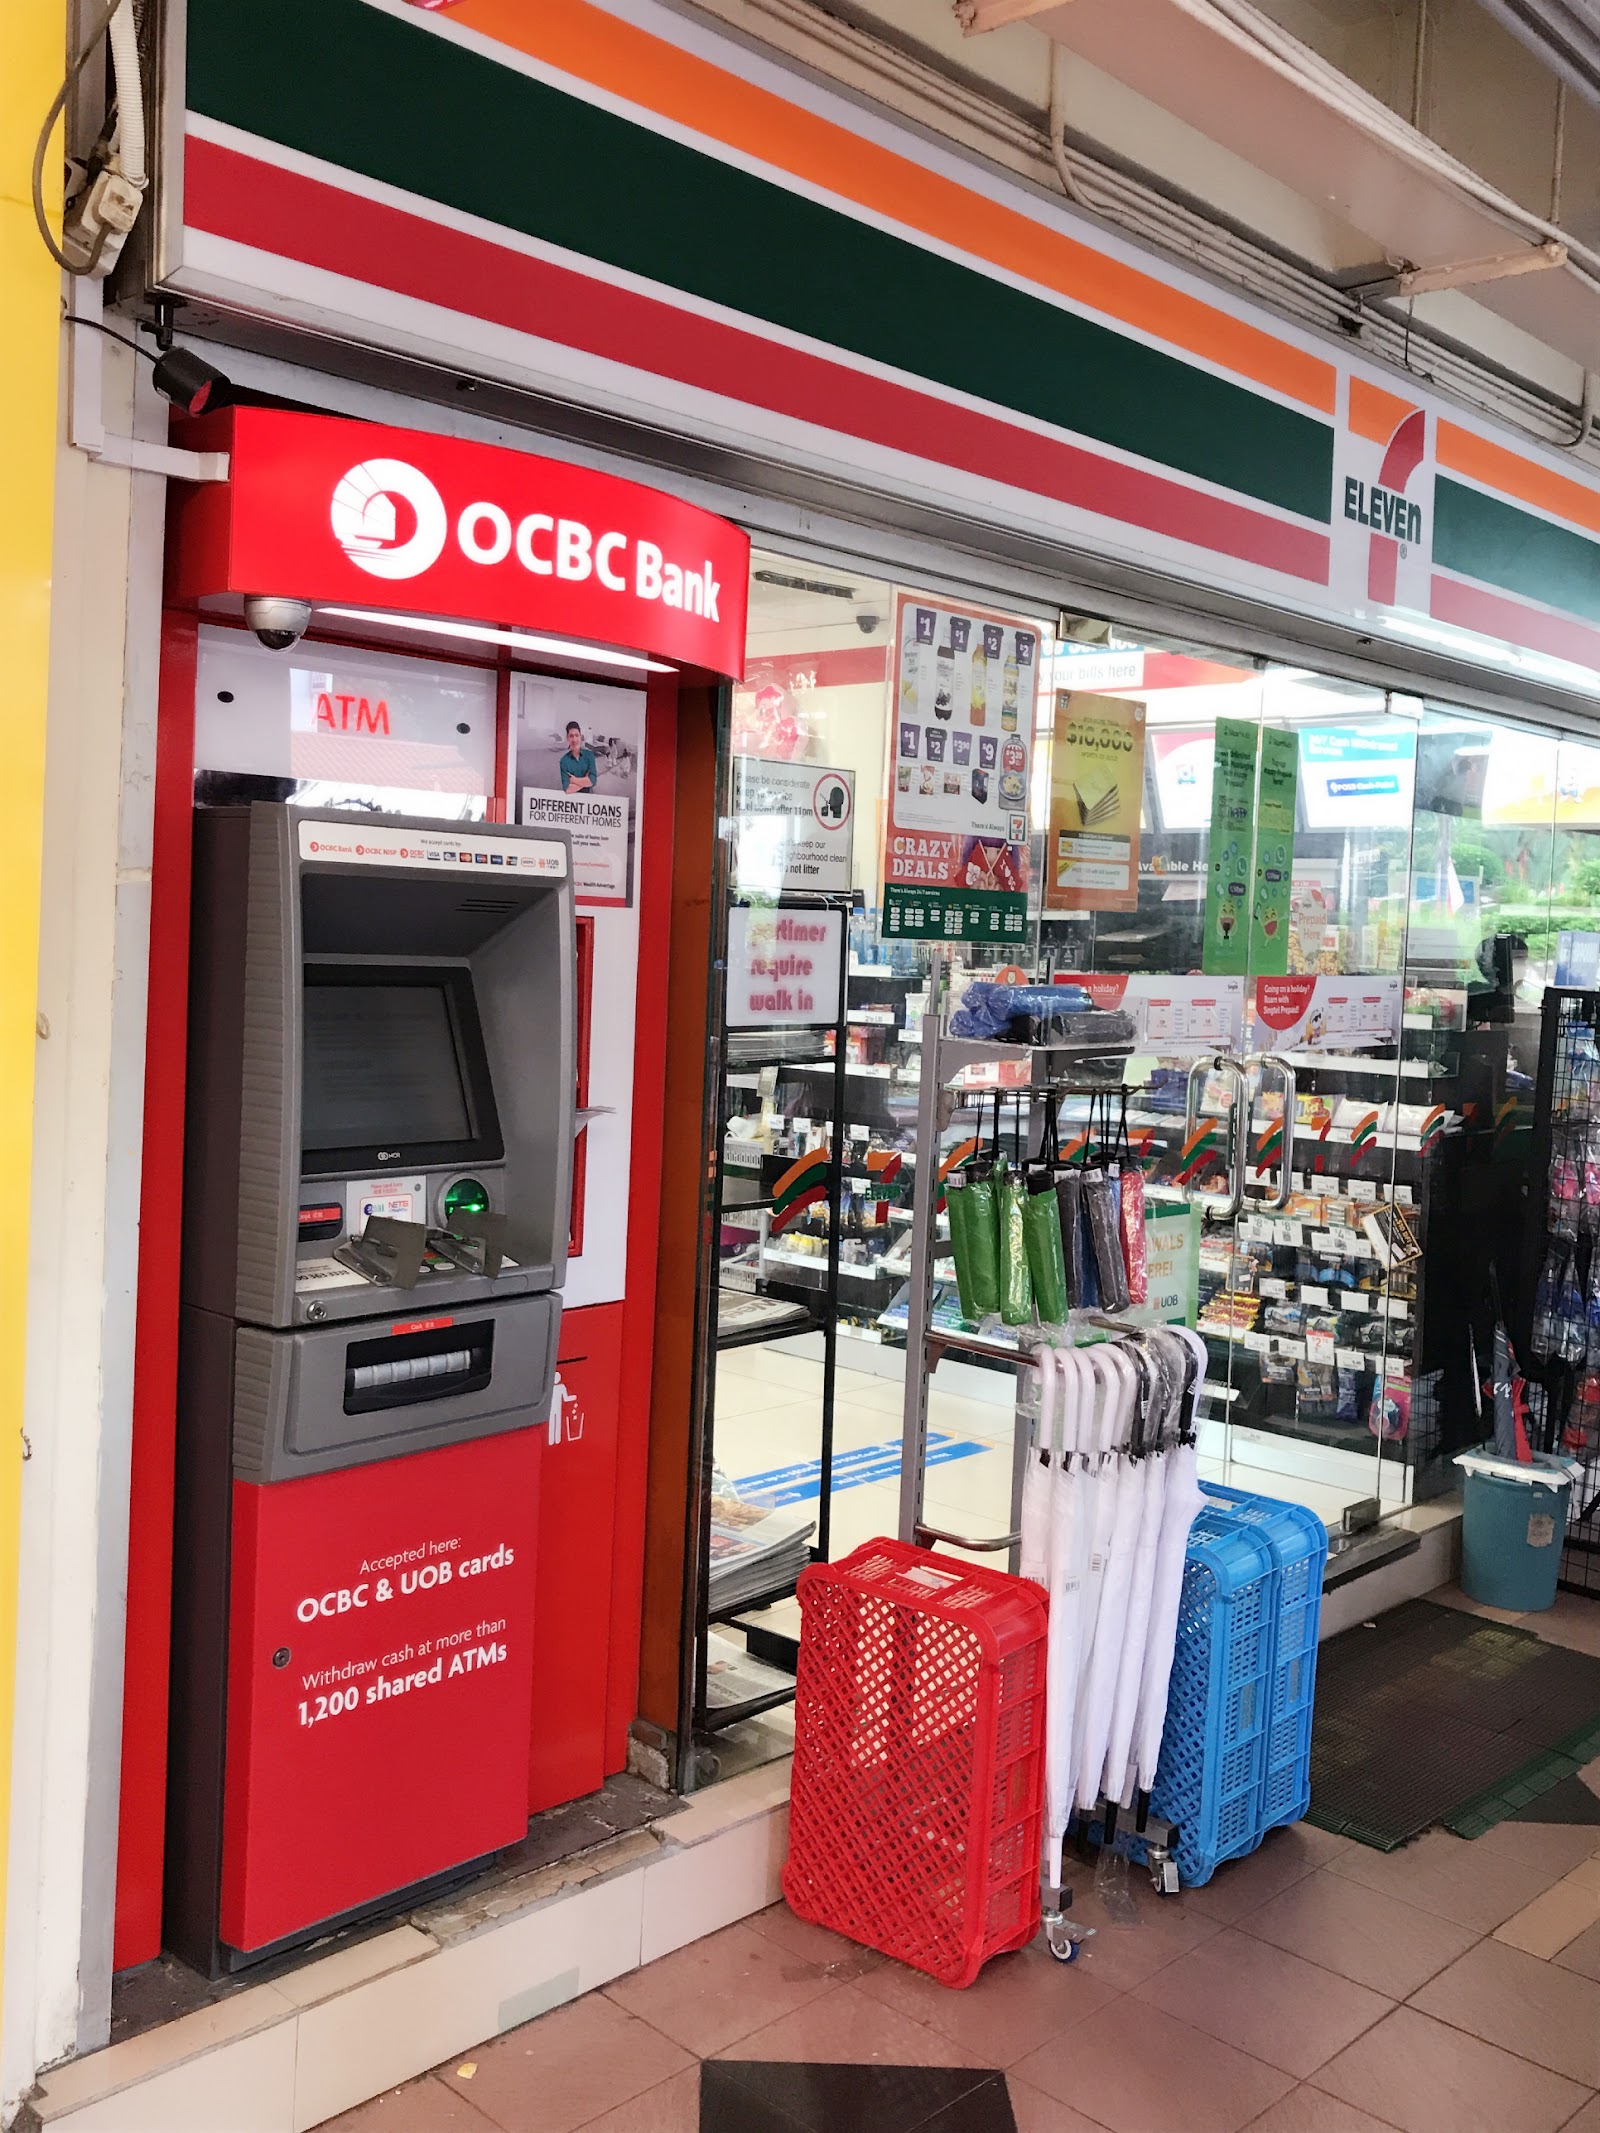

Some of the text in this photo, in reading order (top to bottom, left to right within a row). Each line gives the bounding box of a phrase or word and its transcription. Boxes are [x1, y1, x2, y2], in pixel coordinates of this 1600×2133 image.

[457, 501, 721, 623] OCBC Bank
[1108, 663, 1136, 678] here
[314, 693, 390, 735] ATM
[530, 797, 622, 818] DIFFERENT LOANS
[529, 810, 622, 828] FOR DIFFERENT HOMES
[893, 836, 952, 859] CRAZY
[789, 864, 820, 875] not litter
[891, 858, 949, 881] DEALS
[1298, 913, 1327, 925] Prepaid
[1303, 928, 1321, 940] Here
[750, 954, 813, 982] require
[749, 988, 814, 1011] walk in
[1092, 983, 1120, 995] holiday?
[1263, 984, 1281, 995] Going
[1290, 984, 1310, 995] holiday?
[1263, 995, 1290, 1003] Roam with
[388, 1200, 409, 1208] NETS
[1160, 1294, 1179, 1308] UOB
[359, 1536, 462, 1575] Accepted here:
[296, 1542, 515, 1623] OCBC & UOB cards
[301, 1618, 507, 1691] Withdraw cash at more than
[297, 1641, 508, 1729] 1,200 shared ATMs
